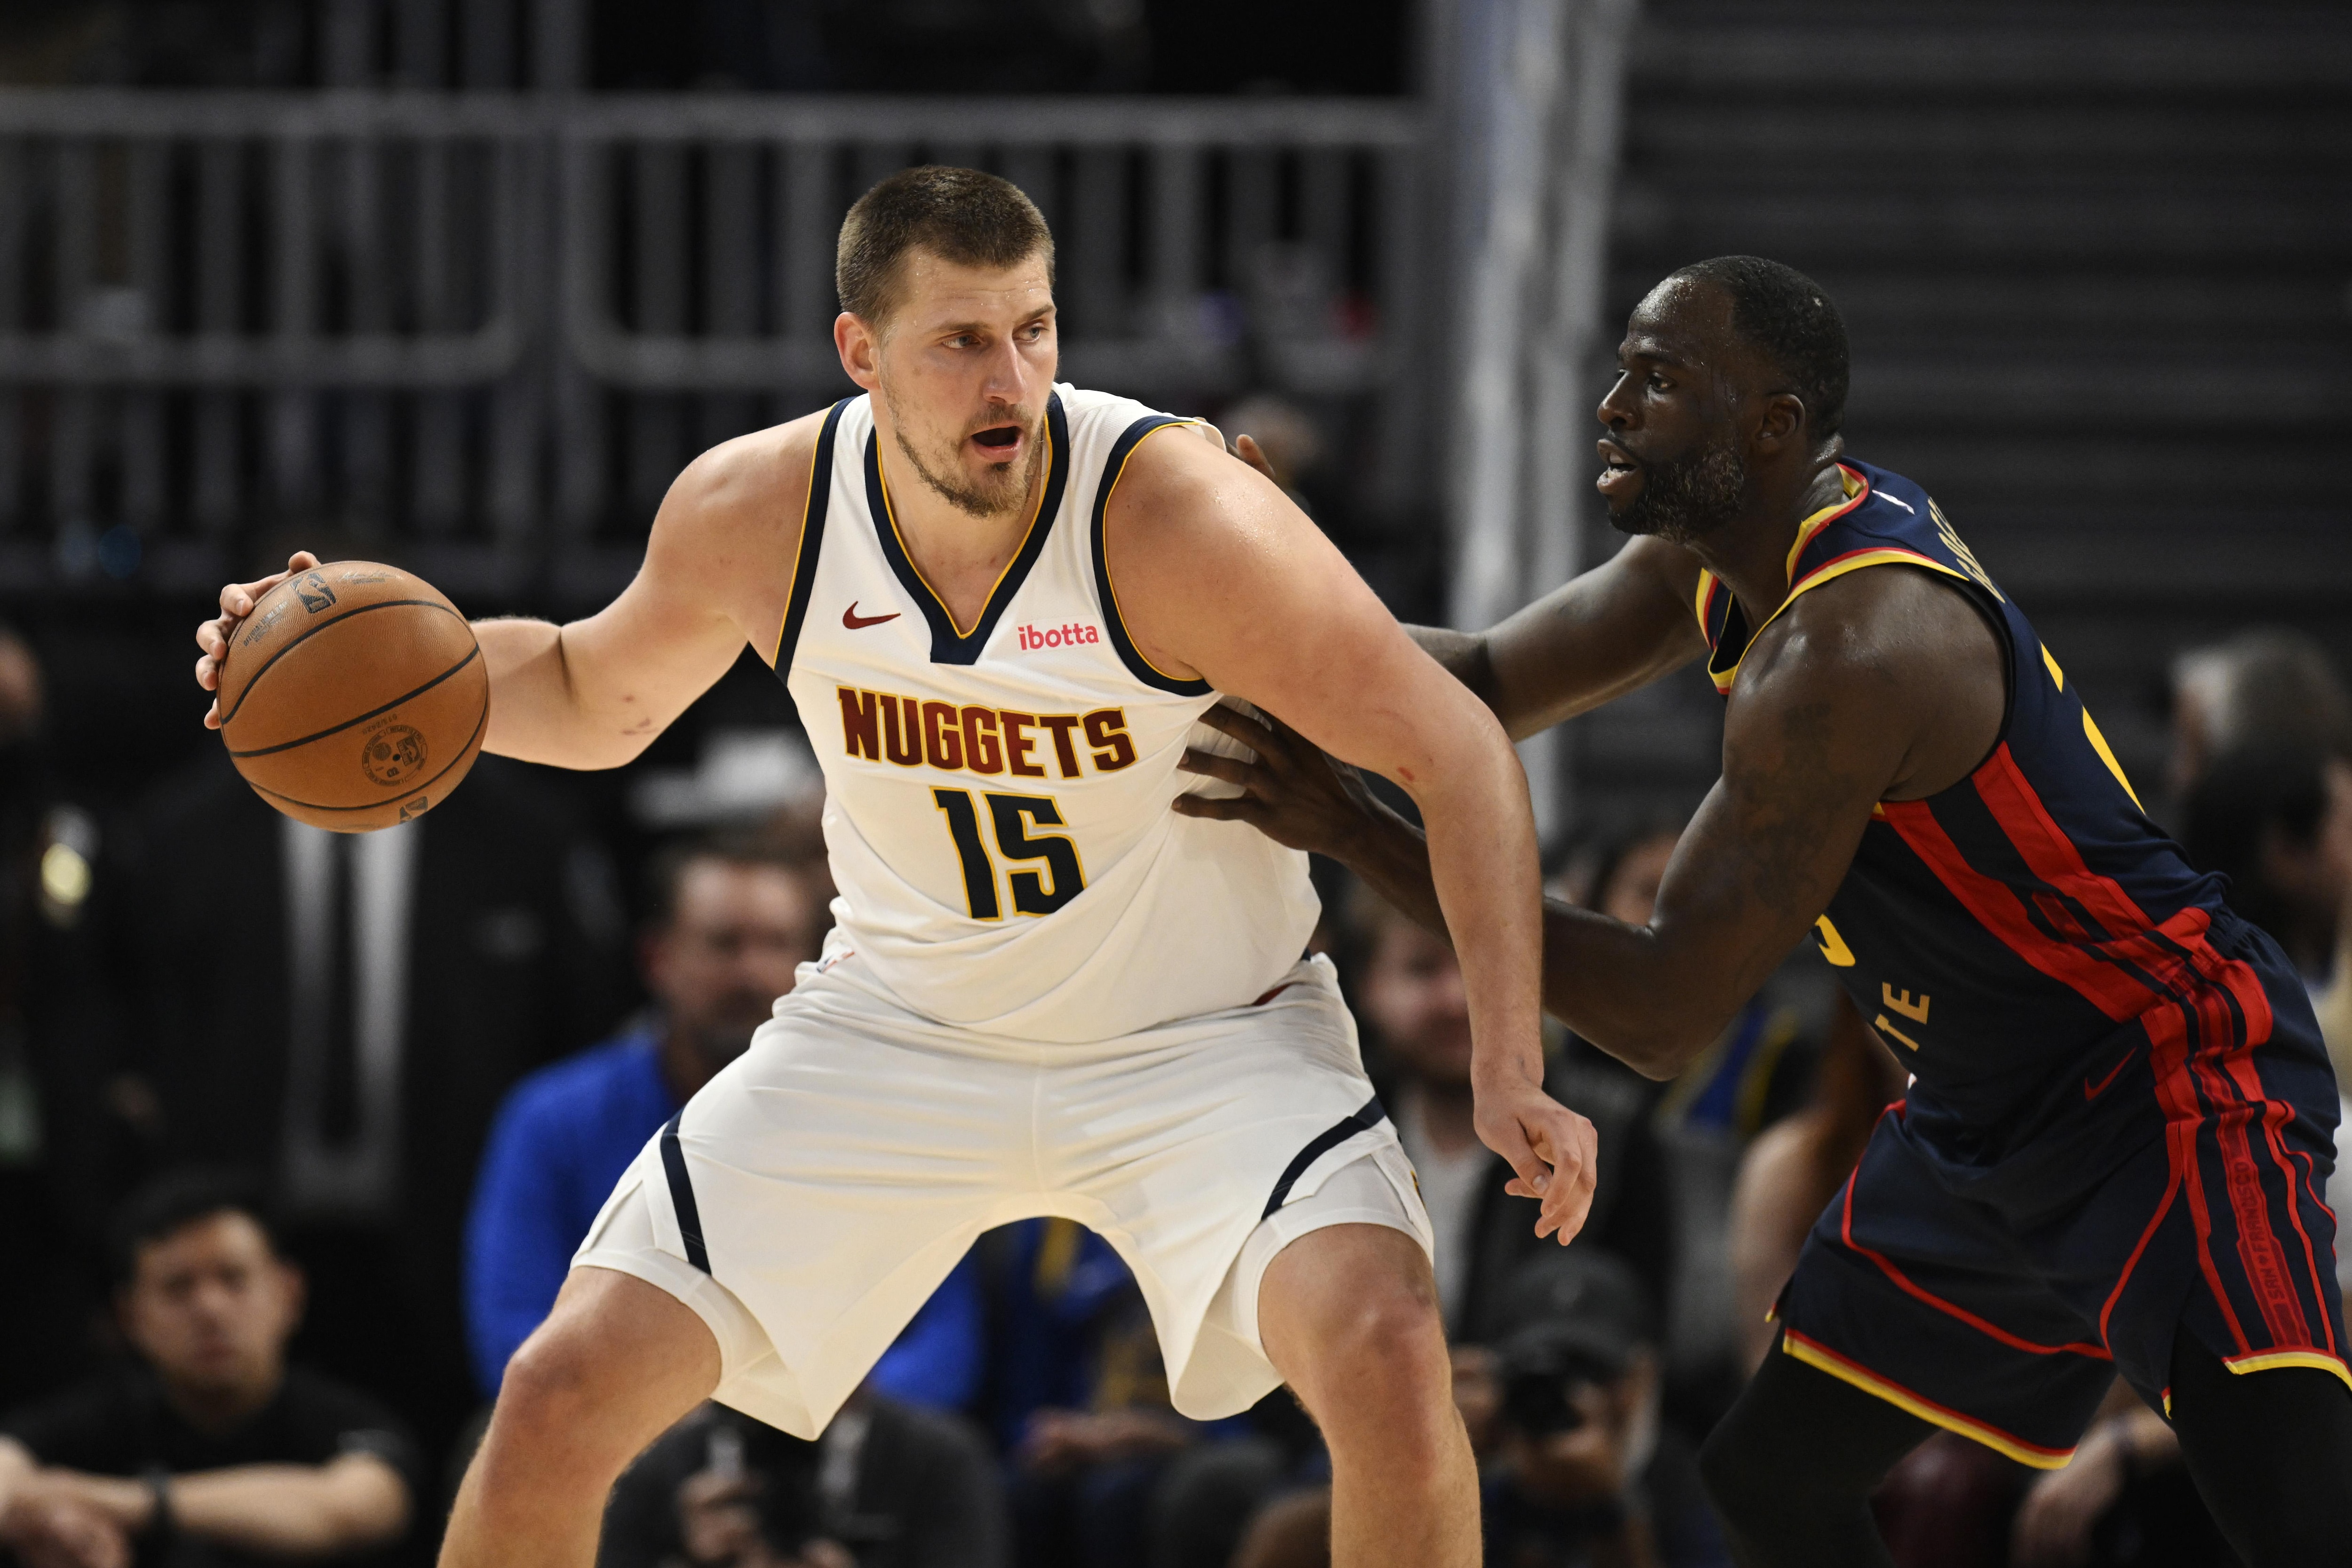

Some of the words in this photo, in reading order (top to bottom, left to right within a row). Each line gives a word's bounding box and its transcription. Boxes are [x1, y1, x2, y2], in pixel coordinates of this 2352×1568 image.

[1018, 623, 1099, 650] ibotta
[836, 685, 1138, 780] NUGGETS
[929, 785, 1088, 922] 15
[2261, 1268, 2285, 1299] SAN
